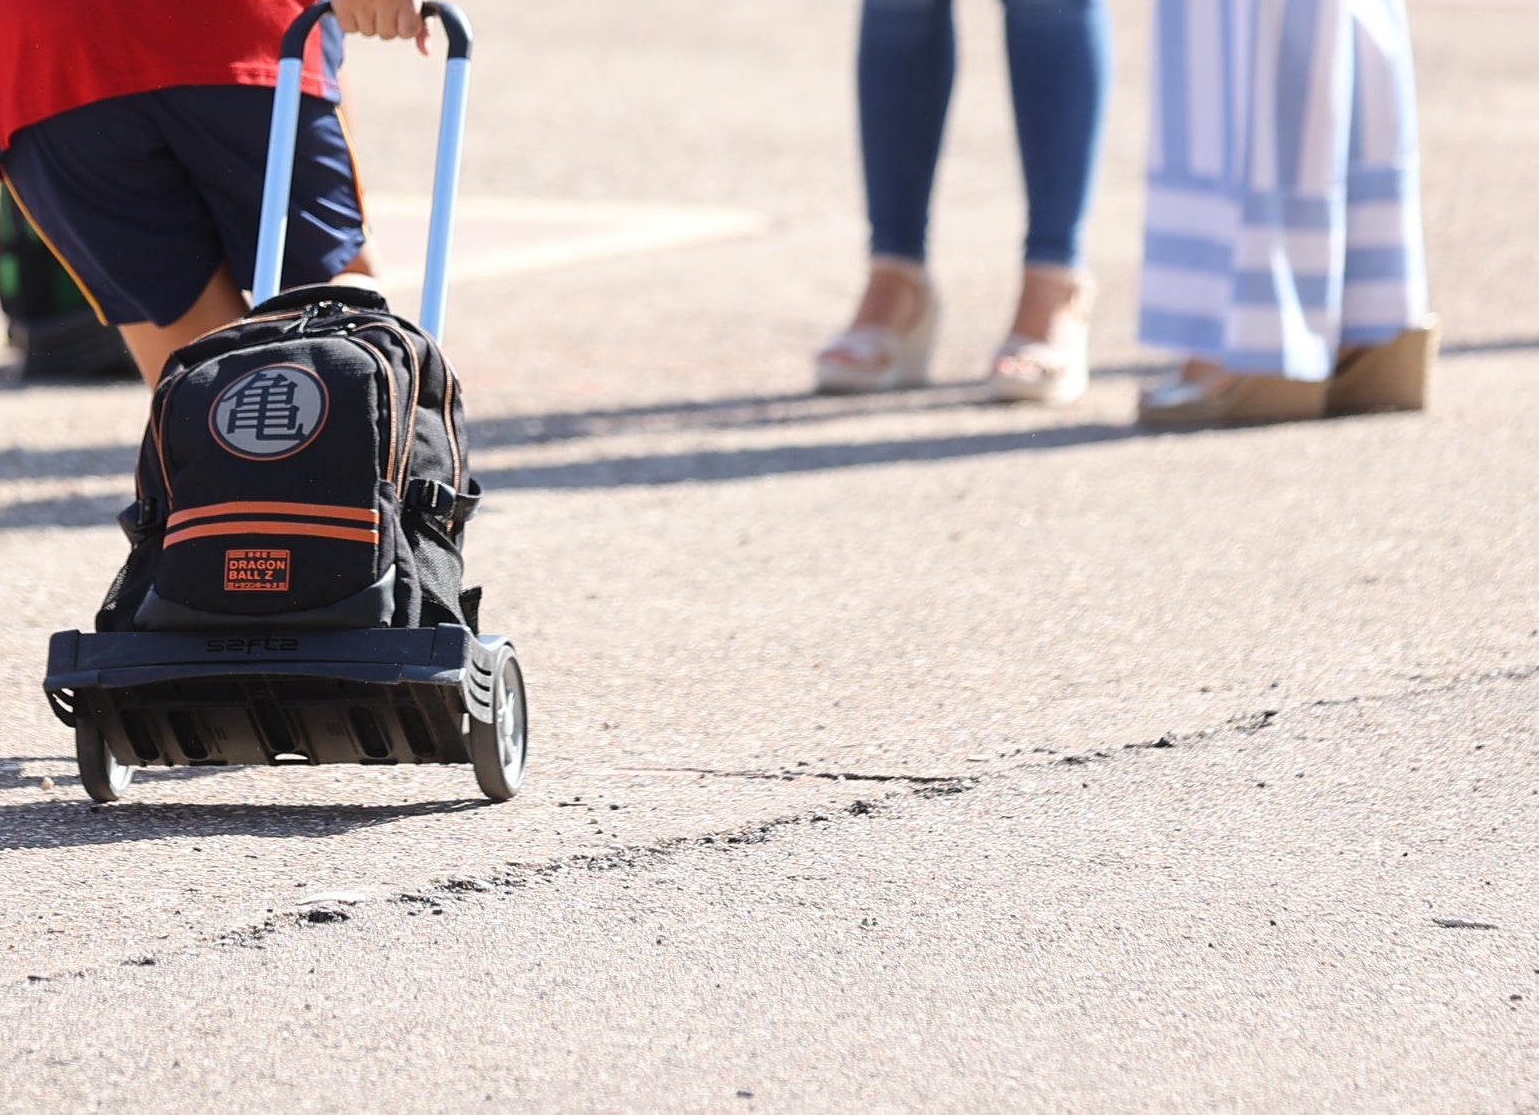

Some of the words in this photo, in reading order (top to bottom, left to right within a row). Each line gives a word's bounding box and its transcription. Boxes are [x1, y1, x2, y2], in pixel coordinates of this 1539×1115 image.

[221, 371, 308, 442] 亀
[229, 560, 286, 570] DRAGON
[228, 570, 262, 580] BALL
[264, 570, 274, 580] Z
